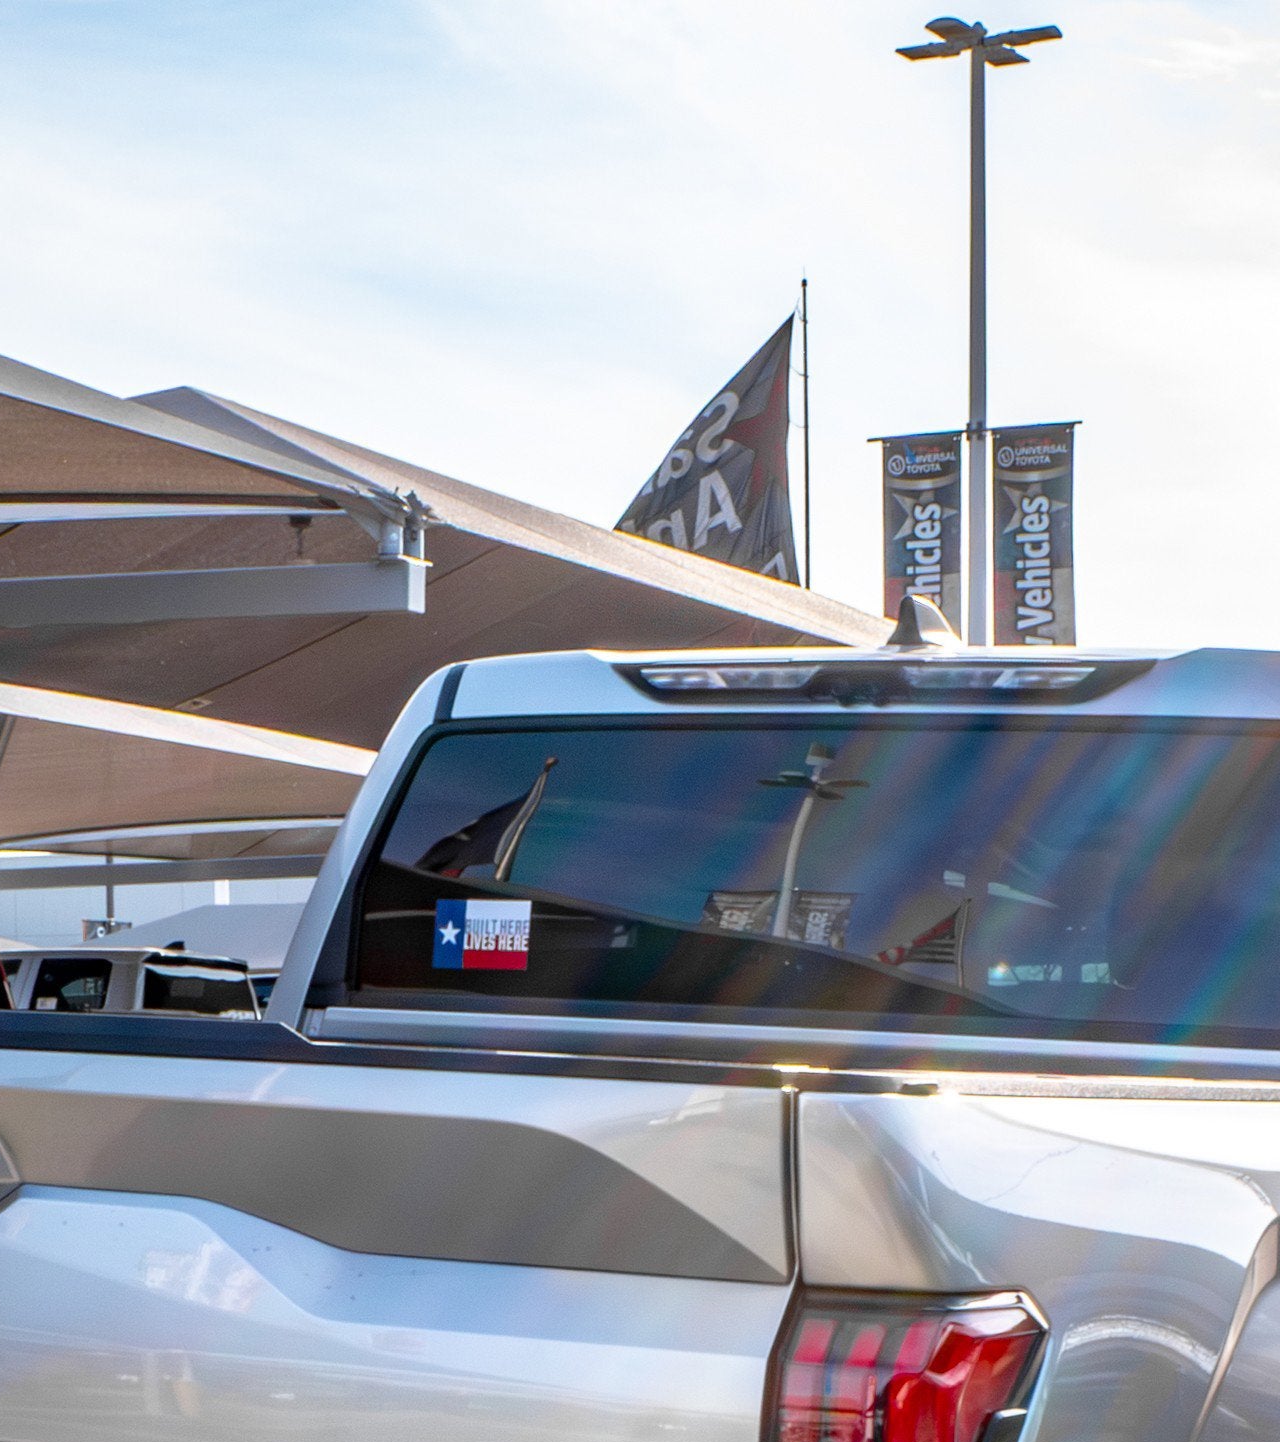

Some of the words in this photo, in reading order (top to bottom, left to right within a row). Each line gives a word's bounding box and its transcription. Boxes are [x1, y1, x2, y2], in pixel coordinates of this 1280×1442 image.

[906, 463, 942, 475] TOYOTA
[1015, 455, 1051, 466] TOYOTA
[906, 503, 942, 604] hicles
[1016, 495, 1053, 630] Vehicles
[465, 919, 498, 935] BUILT
[500, 919, 529, 935] HERE
[464, 933, 497, 950] LIVES
[498, 934, 529, 951] HERE
